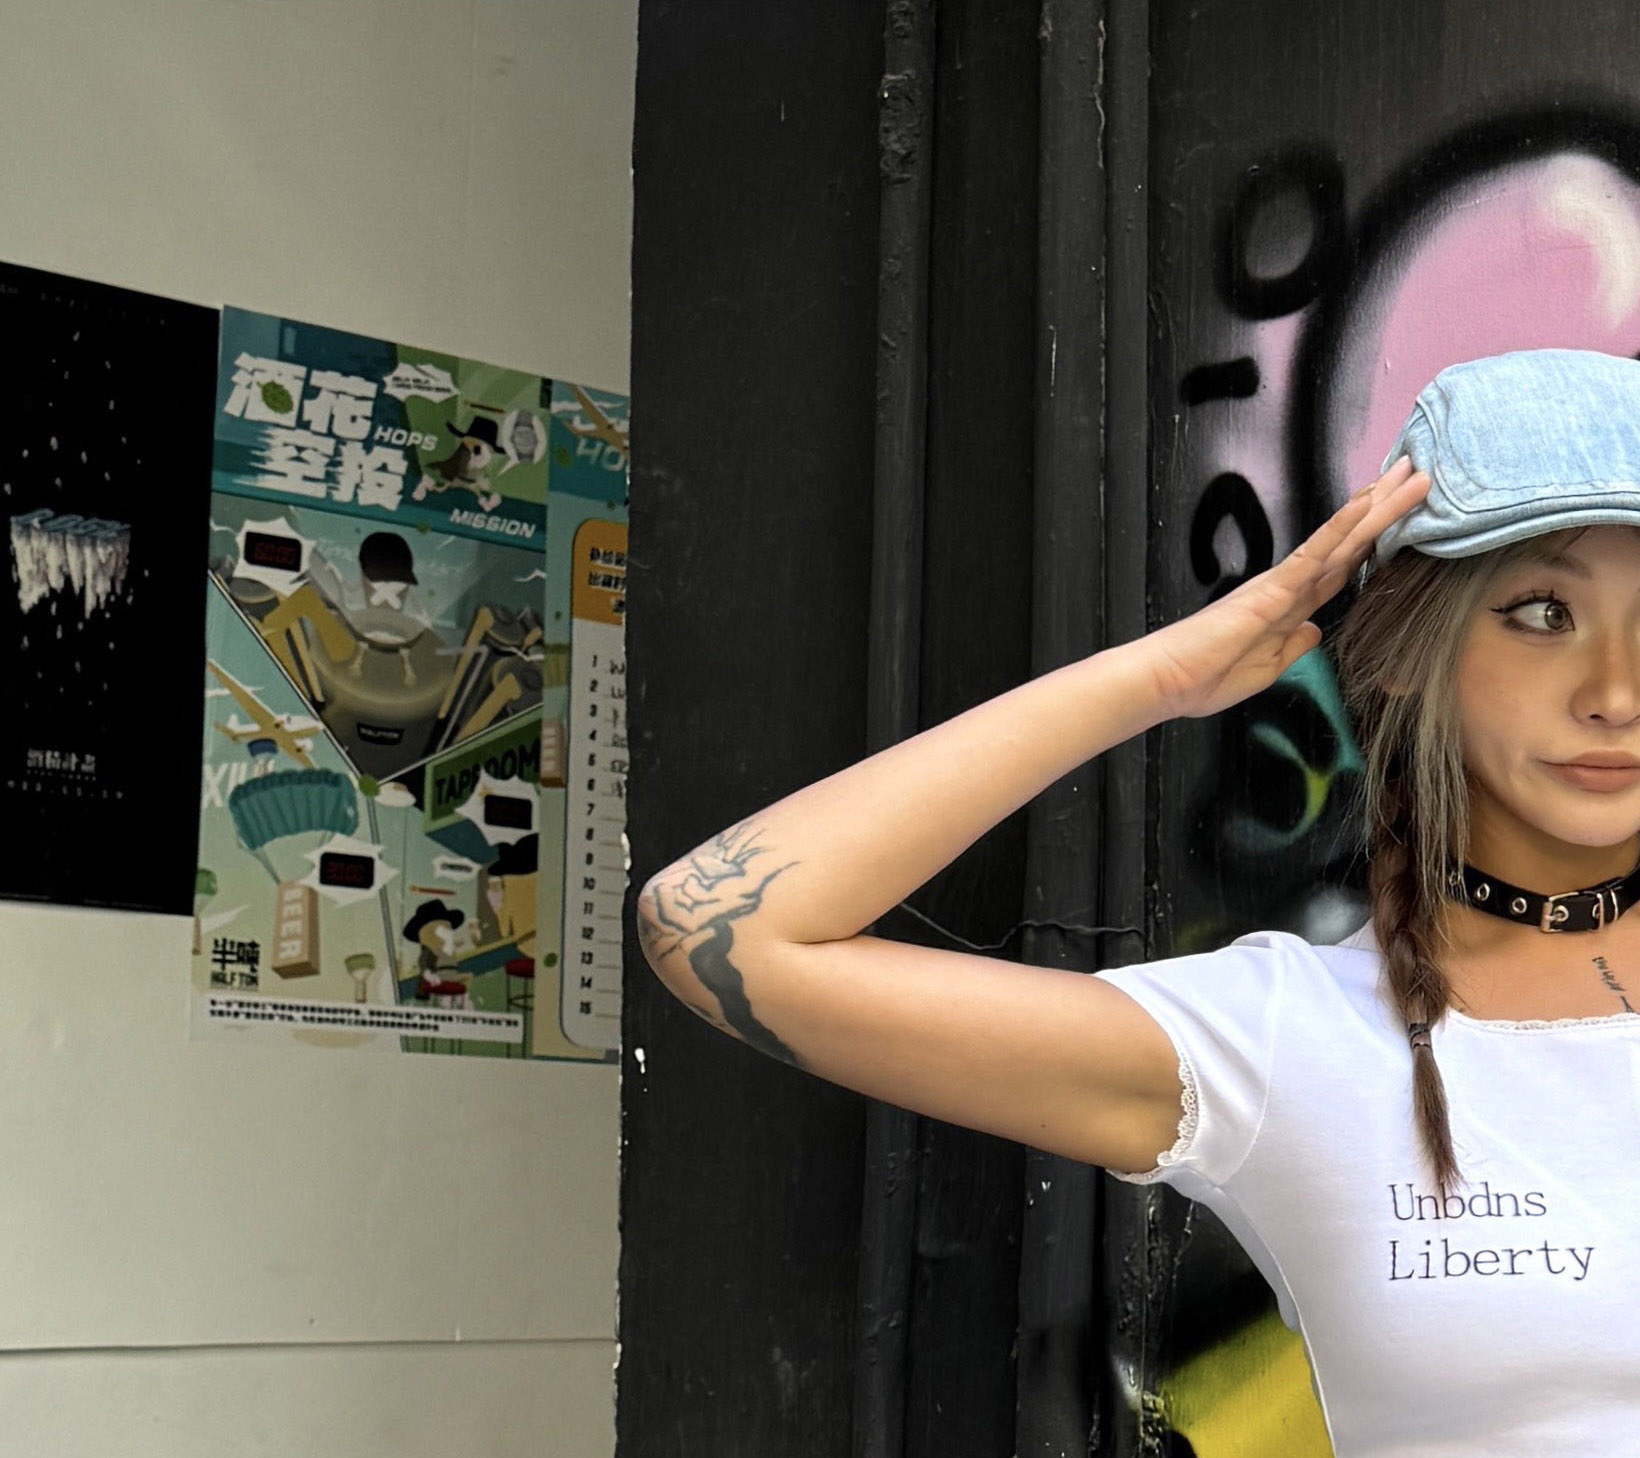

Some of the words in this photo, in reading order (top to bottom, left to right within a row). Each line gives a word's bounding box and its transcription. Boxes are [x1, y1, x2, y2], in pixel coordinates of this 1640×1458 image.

[374, 426, 439, 451] HOPS
[450, 508, 537, 539] MISSION
[593, 655, 598, 668] 1
[590, 679, 598, 692] 2
[590, 704, 598, 717] 3
[589, 730, 597, 741] 4
[586, 803, 595, 816] 7
[583, 876, 596, 890] 10
[583, 902, 593, 915] 11
[278, 887, 303, 960] BEER
[582, 926, 594, 939] 12
[580, 976, 592, 990] 14
[1387, 1181, 1548, 1221] Unbdns
[1388, 1238, 1596, 1281] Liberty
